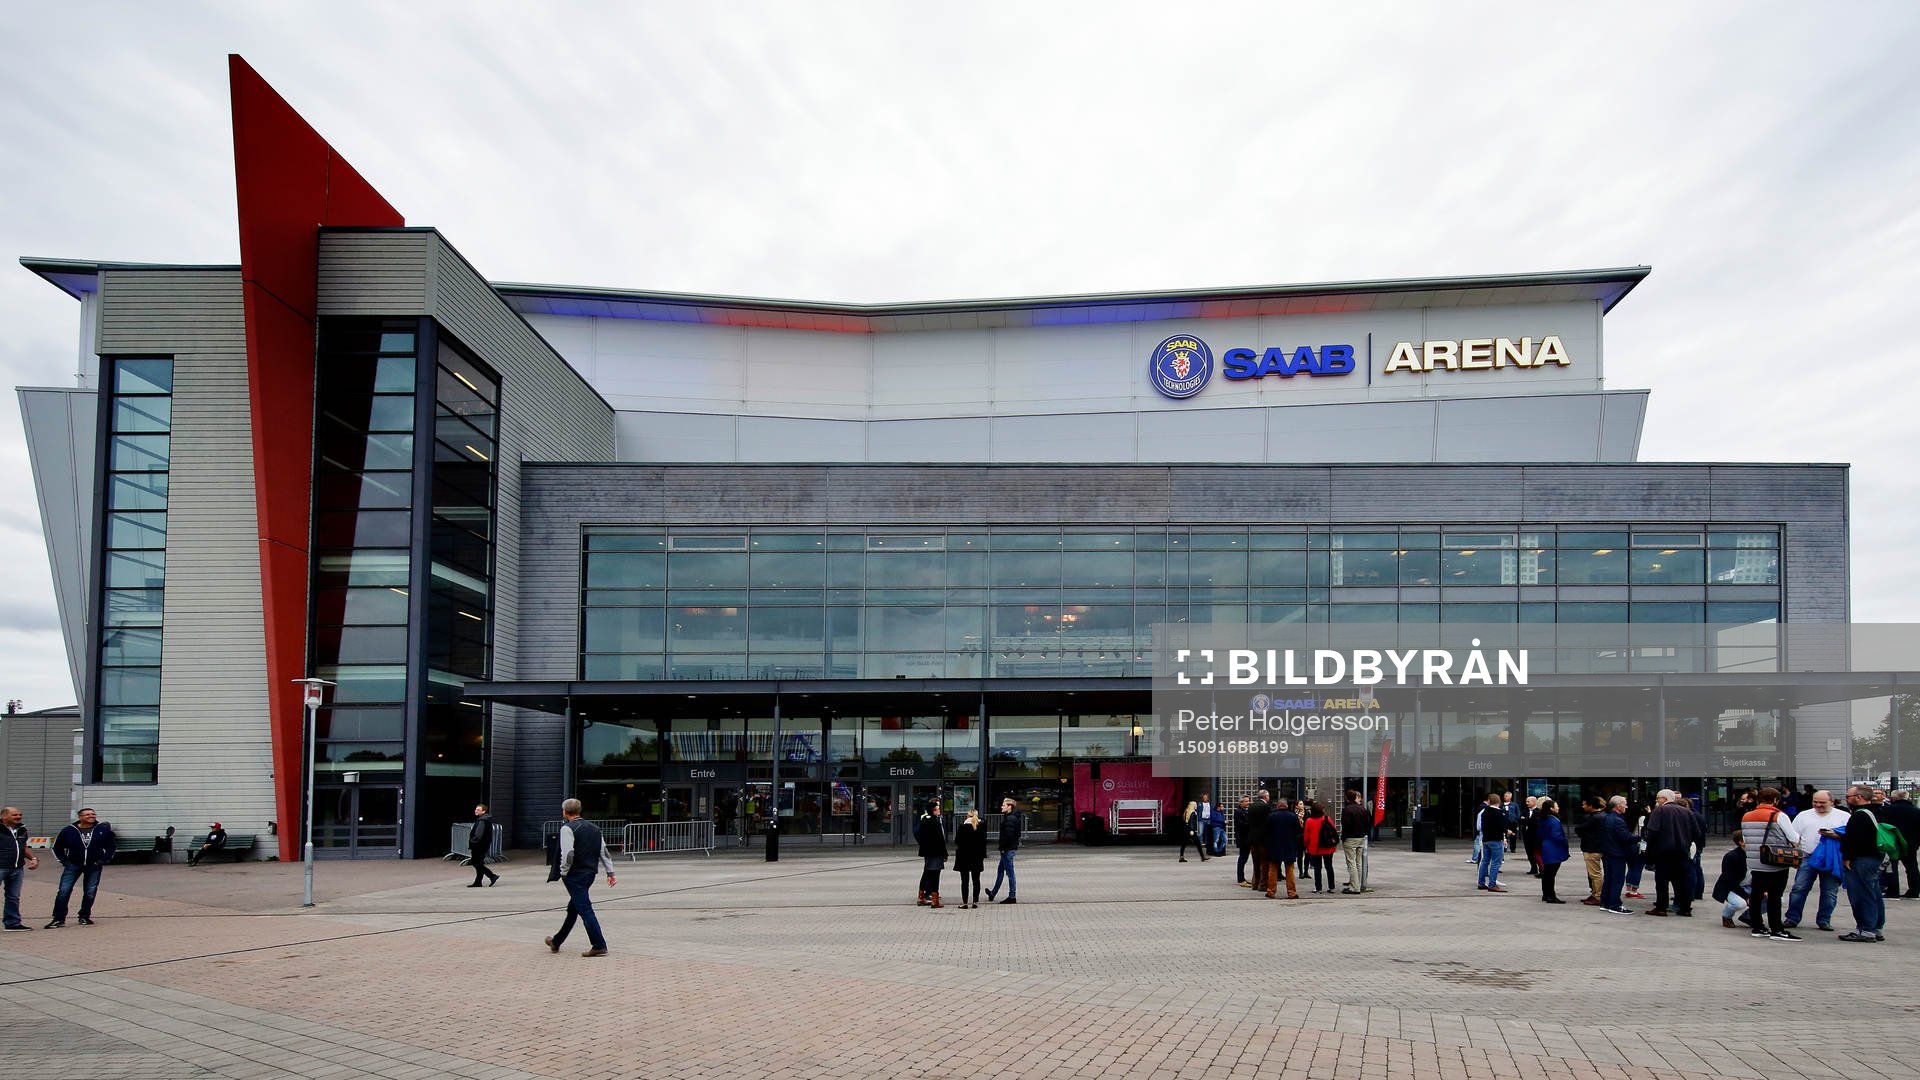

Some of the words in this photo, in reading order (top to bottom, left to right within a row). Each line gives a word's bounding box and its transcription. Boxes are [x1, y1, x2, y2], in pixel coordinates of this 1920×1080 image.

[1166, 340, 1198, 351] SAAB
[1223, 345, 1355, 379] SAAB
[1384, 336, 1570, 372] ARENA
[1163, 376, 1201, 391] TECHNOLOGIES
[1274, 699, 1315, 709] SAAB
[1468, 760, 1493, 770] Entré
[1664, 758, 1681, 768] ntré
[1723, 759, 1767, 767] Biljettkassa
[690, 769, 716, 778] Entré
[889, 767, 915, 776] Entré
